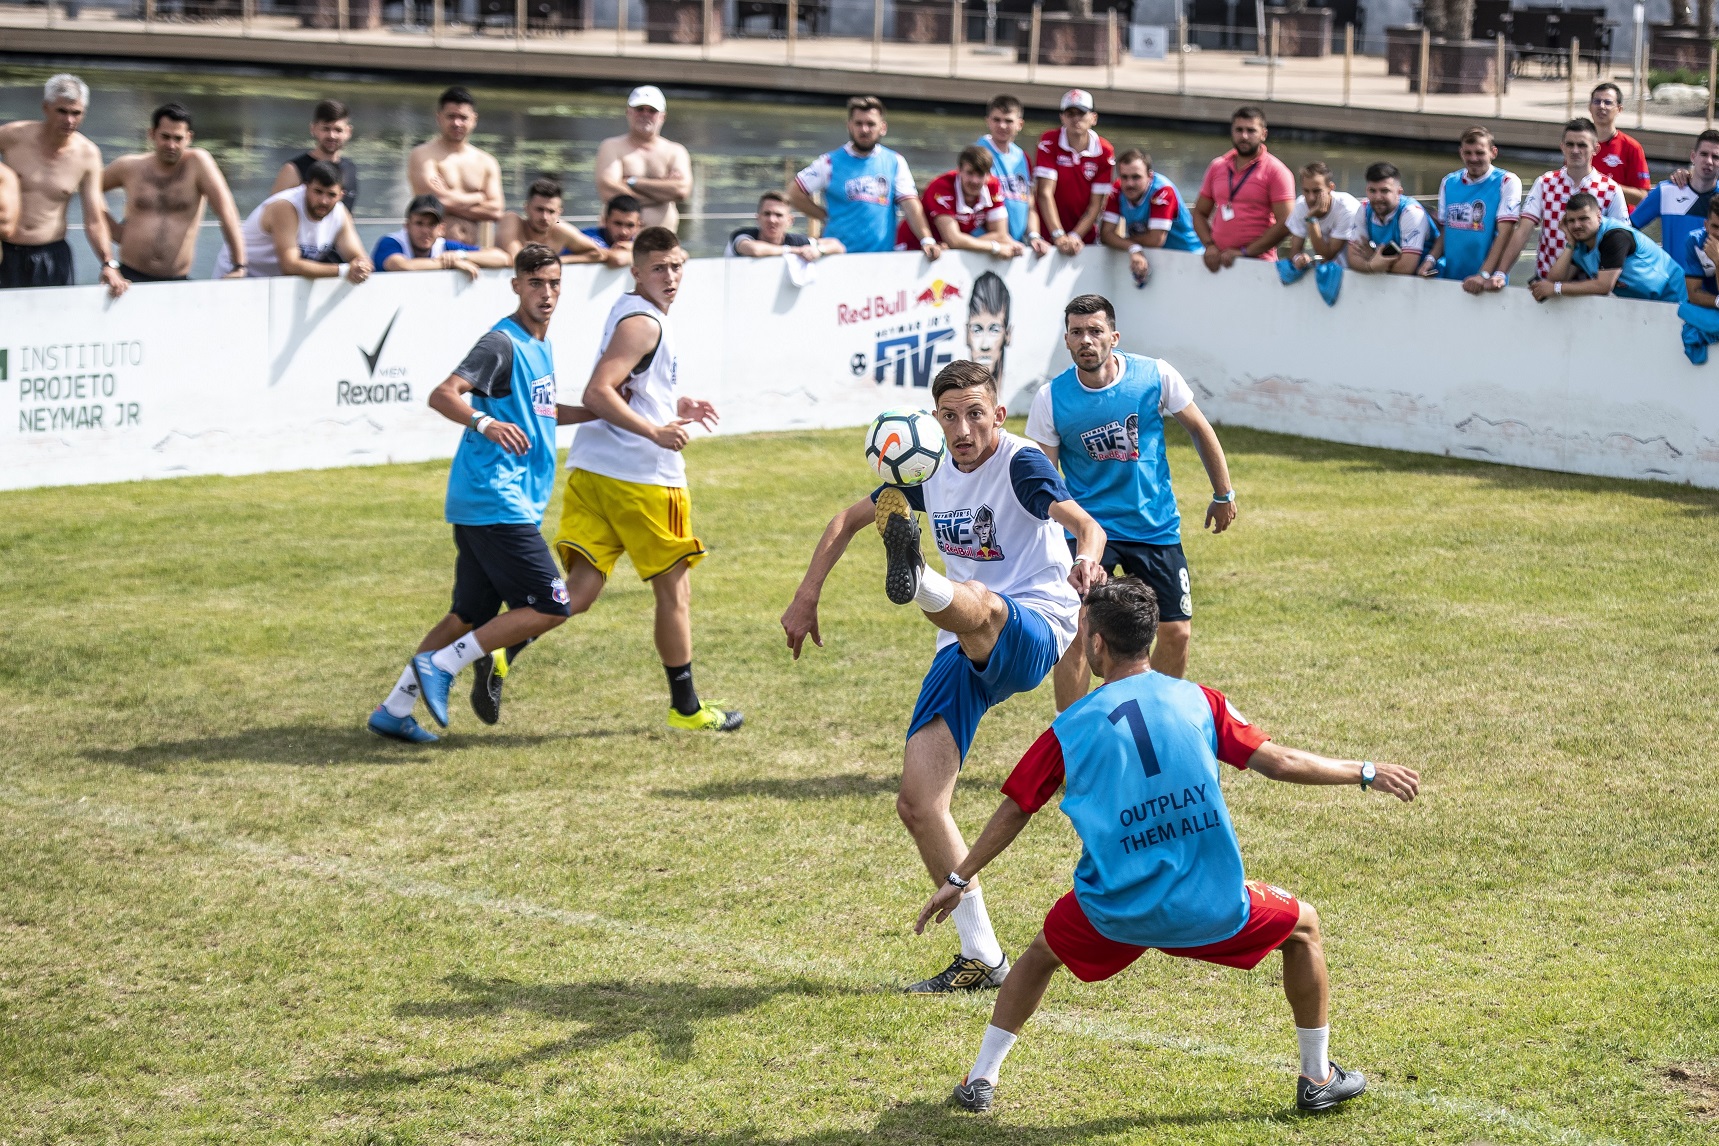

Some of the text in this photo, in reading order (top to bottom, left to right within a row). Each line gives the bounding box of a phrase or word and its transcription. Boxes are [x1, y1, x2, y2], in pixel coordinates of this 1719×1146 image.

[837, 290, 907, 327] Red Bull
[20, 341, 142, 372] INSTITUTO
[380, 367, 406, 377] MEN
[19, 373, 115, 402] PROJETO
[337, 380, 411, 406] Rexona
[19, 402, 140, 433] NEYMAR JR
[1082, 427, 1105, 437] NEYMAR
[1084, 428, 1126, 452] FIVE
[1099, 450, 1127, 461] Red Bull
[934, 518, 973, 545] FIVE
[945, 543, 974, 557] Red Bull
[1178, 567, 1191, 594] 8
[1107, 699, 1161, 778] 1
[1119, 783, 1206, 827] OUTPLAY
[1120, 810, 1220, 854] THEM ALL!
